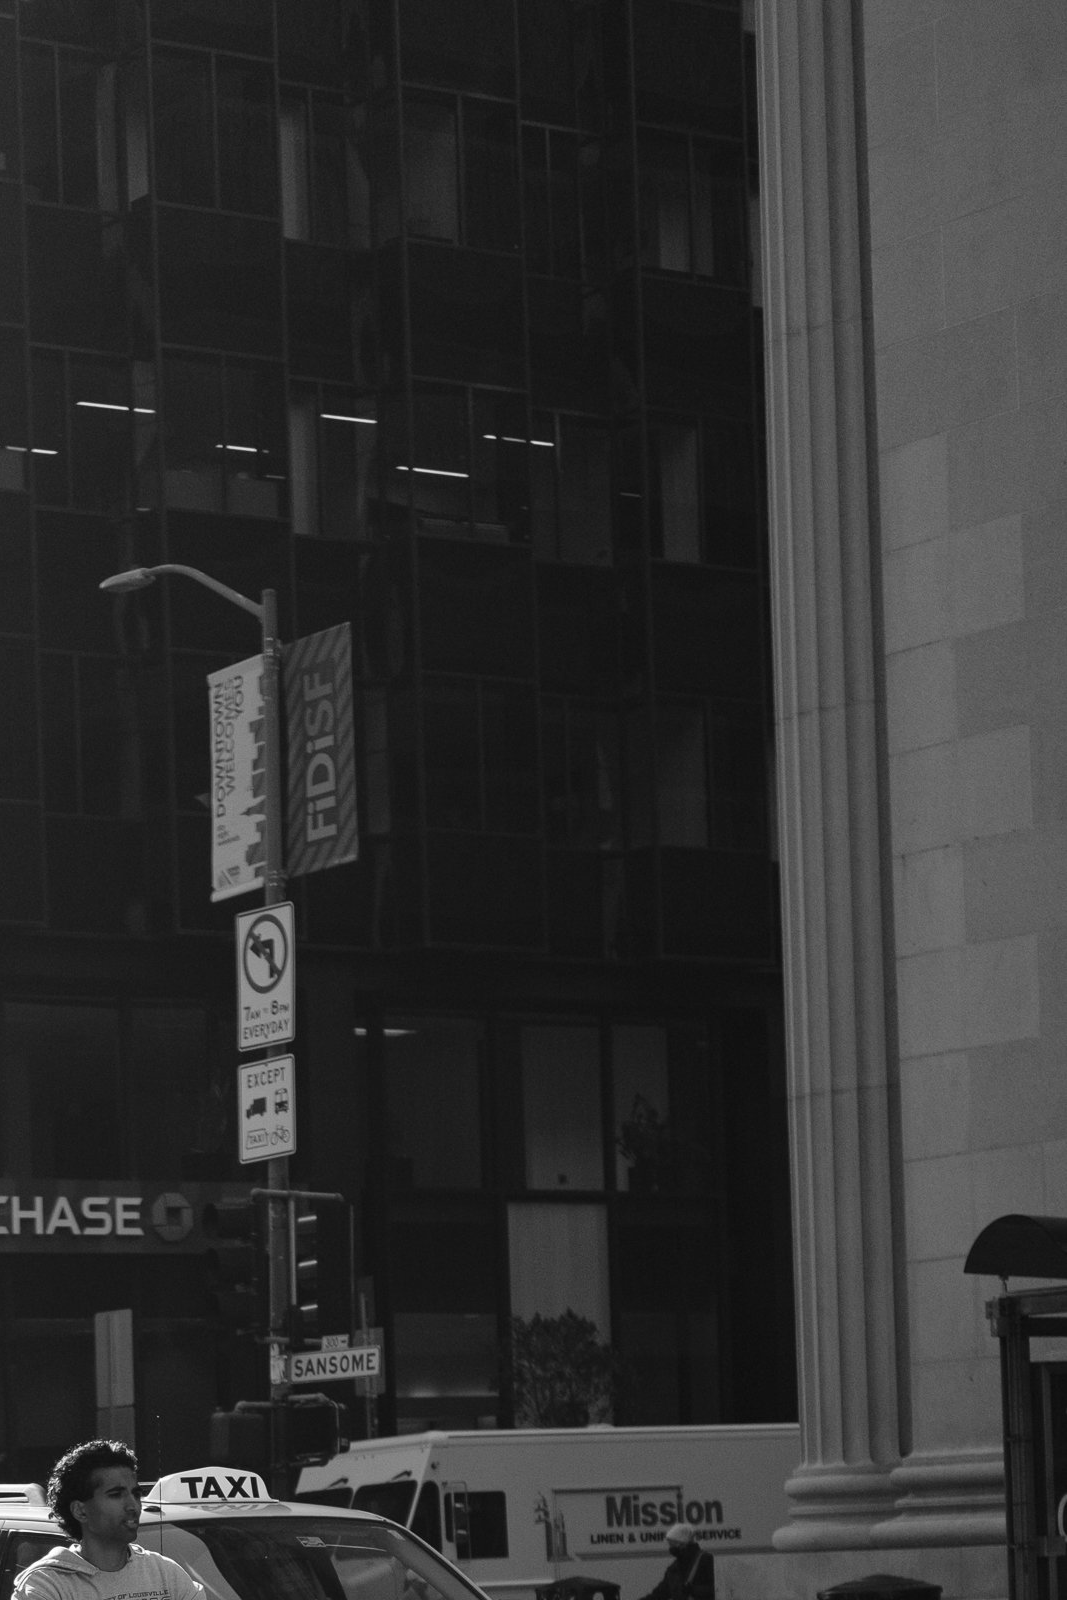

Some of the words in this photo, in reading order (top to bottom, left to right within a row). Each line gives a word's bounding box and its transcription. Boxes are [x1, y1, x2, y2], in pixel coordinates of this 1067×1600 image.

[234, 675, 244, 719] YOU
[224, 678, 237, 797] WELCOMES
[214, 682, 227, 818] DOWNTOWN
[302, 672, 338, 842] FiDiSF
[271, 1000, 289, 1015] 8PM
[243, 1019, 289, 1039] EVERYDAY
[246, 1067, 286, 1088] EXCEPT
[248, 1132, 269, 1144] TAXI
[293, 1352, 377, 1378] SANSOME
[180, 1476, 260, 1499] TAXI
[606, 1494, 724, 1528] Mission
[590, 1532, 625, 1545] LINEN
[628, 1532, 637, 1543] &
[695, 1528, 742, 1541] SERVICE
